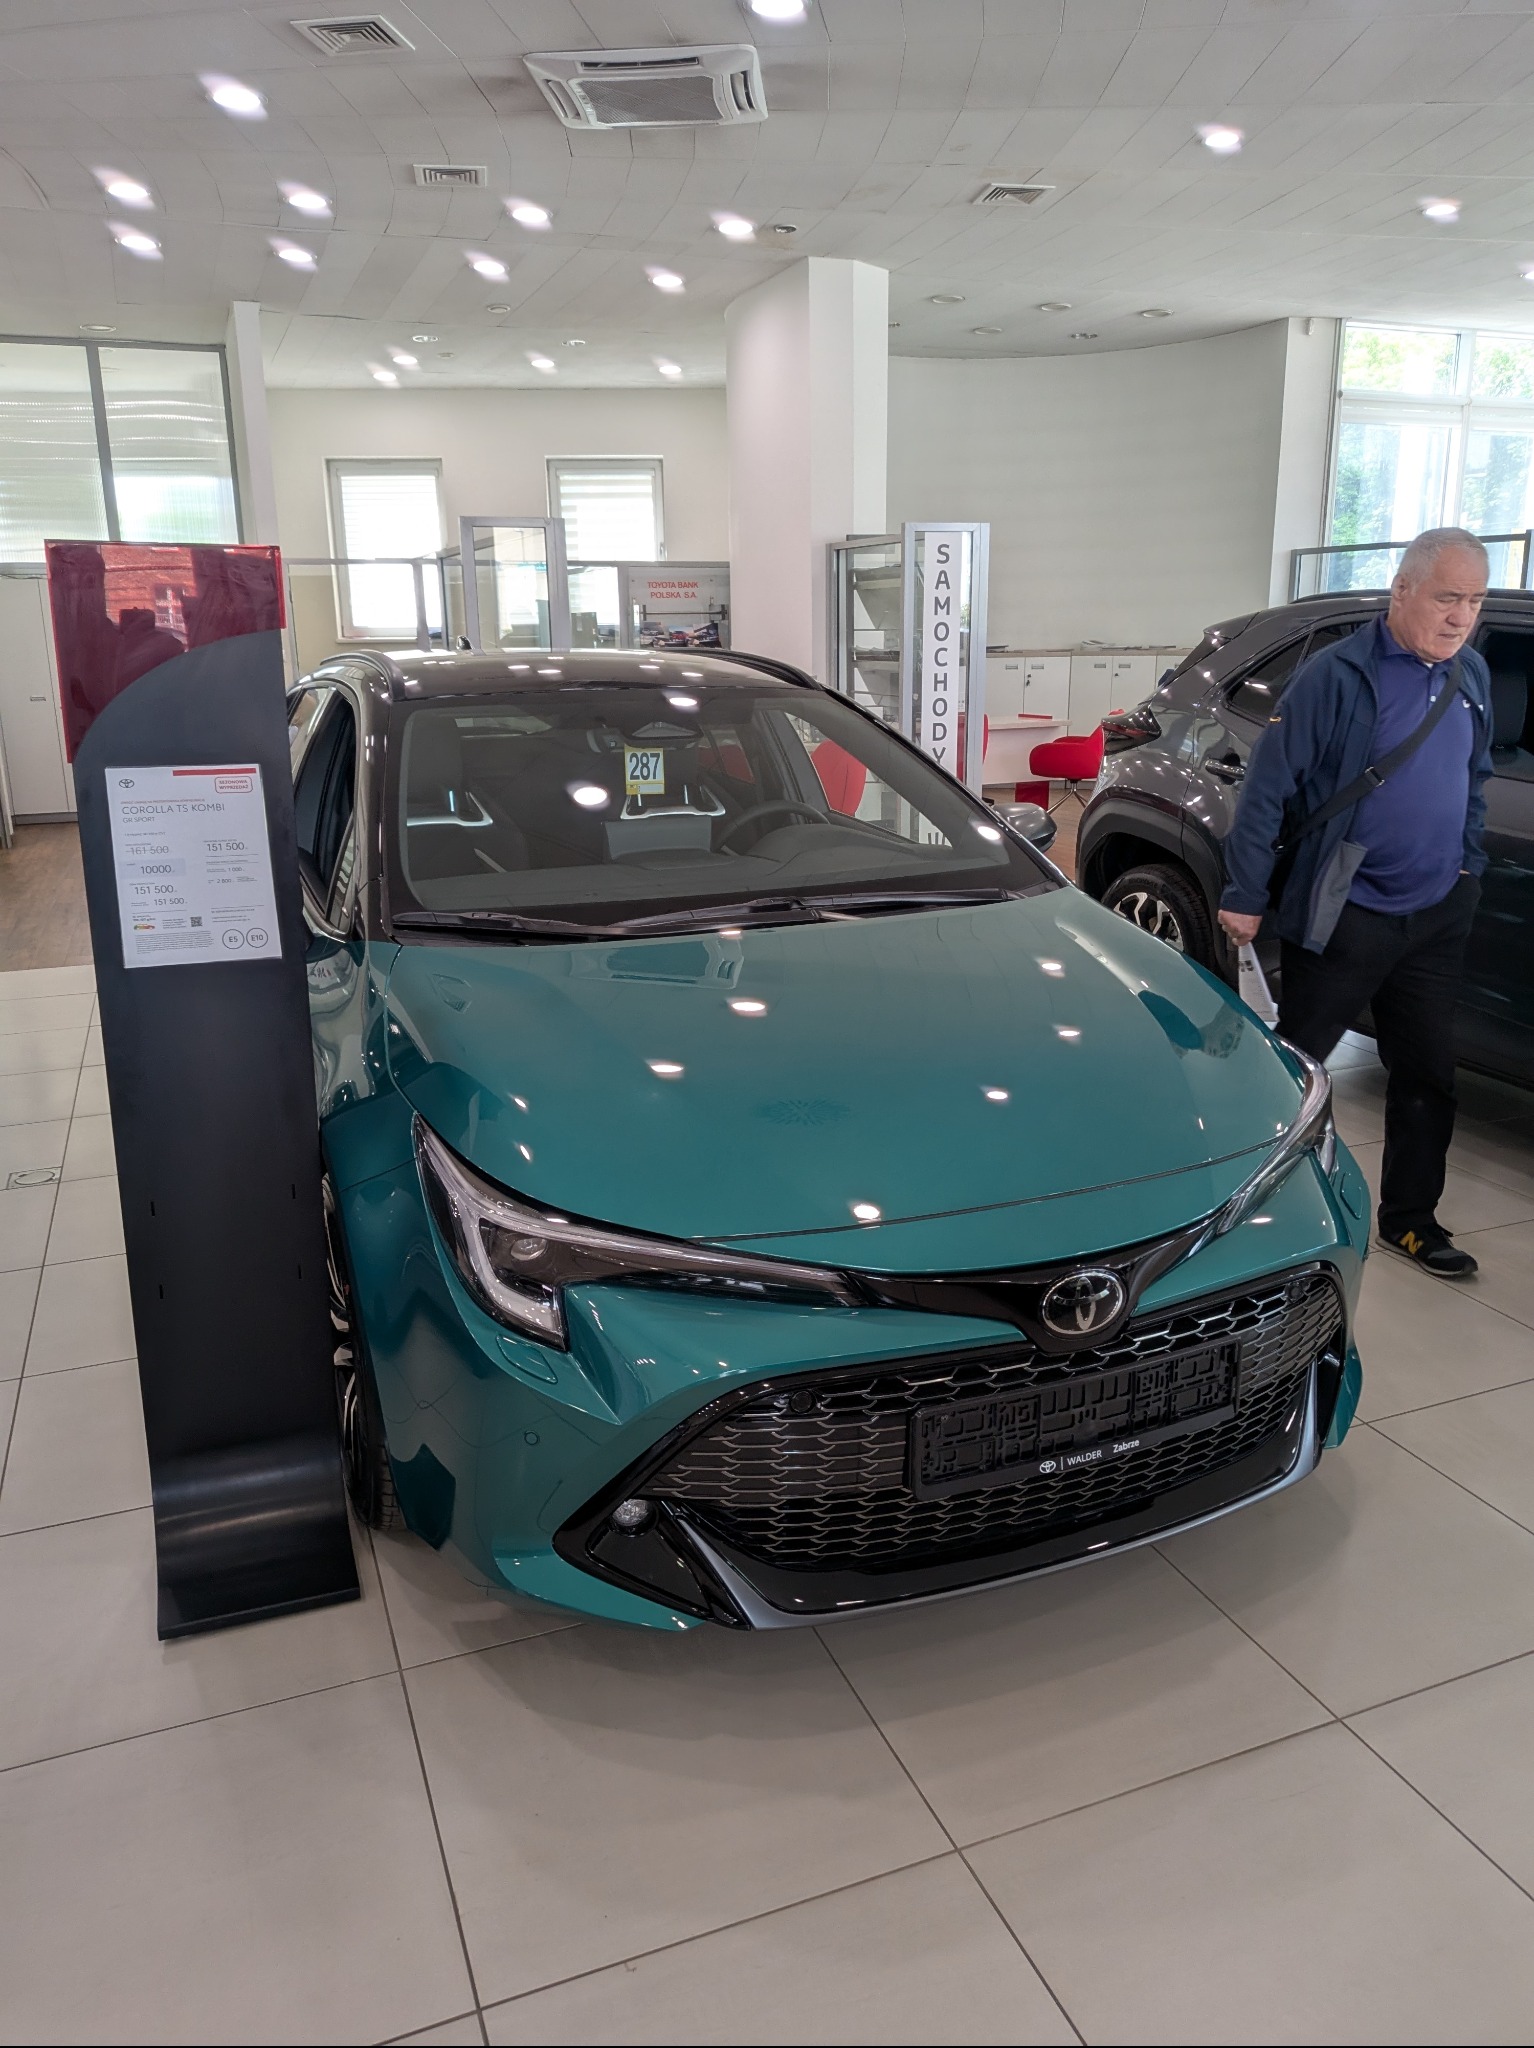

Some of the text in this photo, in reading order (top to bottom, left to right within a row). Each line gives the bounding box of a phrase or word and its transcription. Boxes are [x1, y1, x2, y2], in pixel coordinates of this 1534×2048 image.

[647, 581, 699, 589] TOYOTA BANK
[650, 591, 682, 599] POLSKA
[932, 543, 951, 764] SAMOCHODY
[629, 752, 661, 781] 287
[122, 803, 225, 815] COROLLA TS KOMBI
[206, 842, 245, 852] 151 500
[140, 864, 172, 875] 10000
[134, 884, 174, 895] 151 500
[154, 898, 167, 906] 151
[169, 897, 185, 905] 500
[228, 935, 239, 943] E5
[250, 934, 264, 942] E10
[1400, 1230, 1424, 1255] N
[1066, 1439, 1140, 1466] WALDER Zabrze
